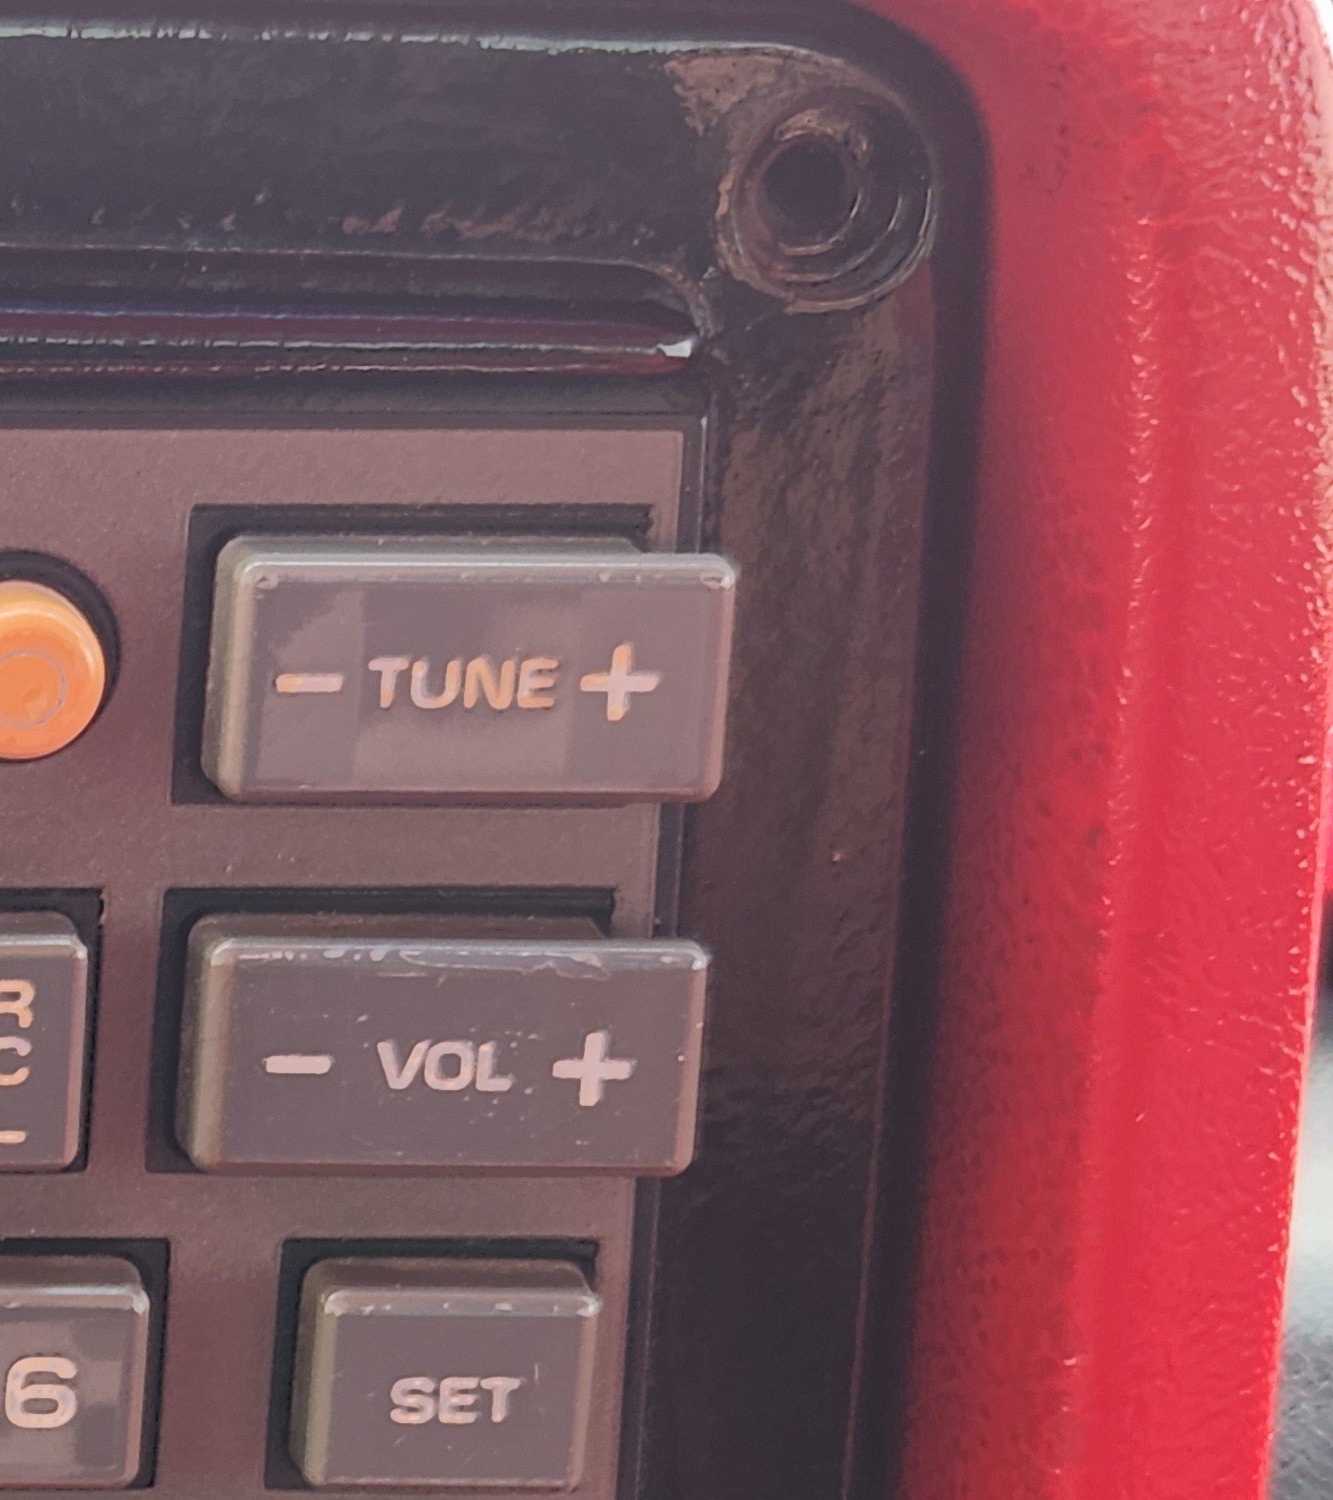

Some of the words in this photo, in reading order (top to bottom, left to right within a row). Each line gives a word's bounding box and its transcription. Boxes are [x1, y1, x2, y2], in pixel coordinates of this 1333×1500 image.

[368, 656, 556, 711] TUNE
[377, 1042, 513, 1093] VOL
[4, 1356, 78, 1429] 6
[390, 1376, 521, 1425] SET
